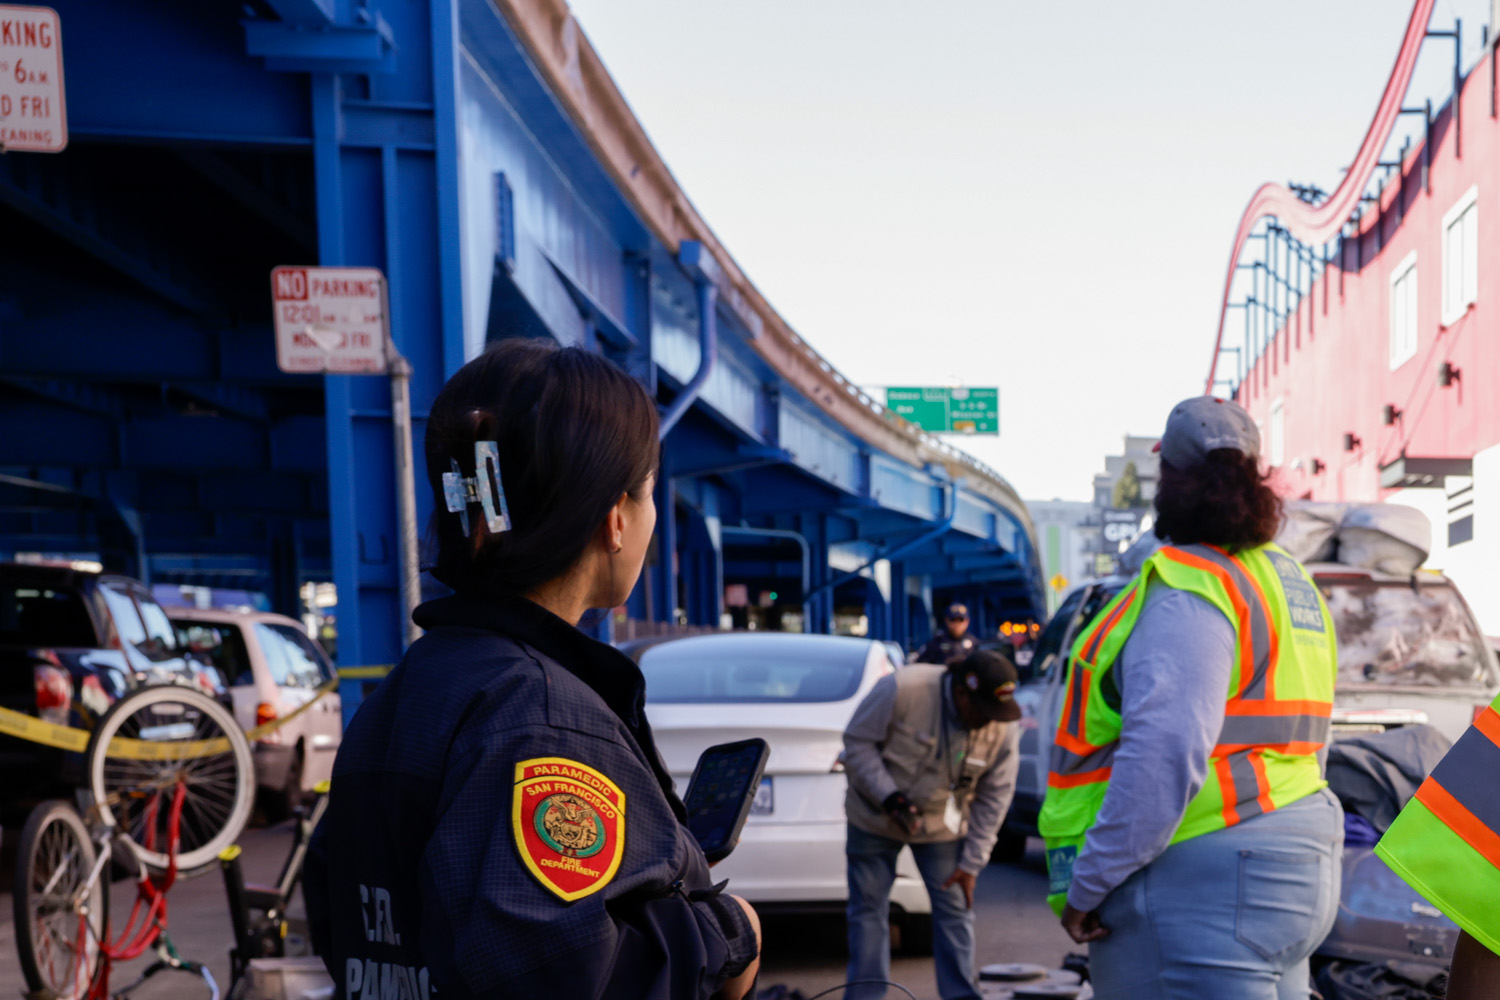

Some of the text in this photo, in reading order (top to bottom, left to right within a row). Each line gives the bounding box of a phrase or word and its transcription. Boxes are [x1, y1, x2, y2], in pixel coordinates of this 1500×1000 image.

[1, 20, 52, 49] KING
[14, 57, 27, 84] 6
[21, 96, 50, 118] FRI
[277, 271, 377, 299] NO PARKING
[533, 765, 612, 796] PARAMEDIC
[526, 783, 552, 796] SAN
[554, 783, 616, 819] FRANCISCO
[540, 858, 601, 878] DEPARTMENT
[561, 856, 582, 867] FIRE
